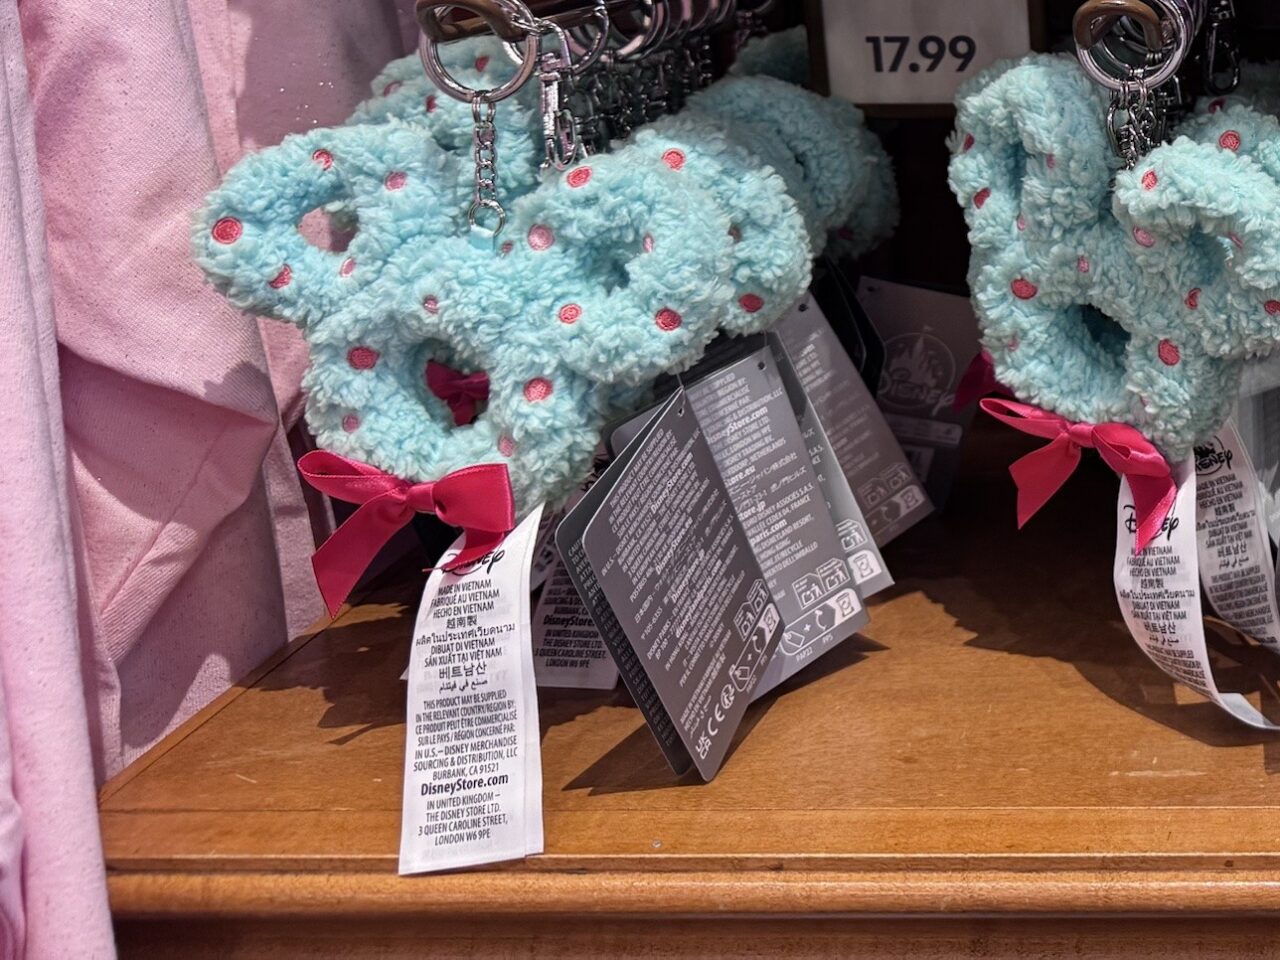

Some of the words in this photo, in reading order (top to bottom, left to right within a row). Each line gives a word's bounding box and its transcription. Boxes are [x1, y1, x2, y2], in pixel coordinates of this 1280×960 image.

[865, 35, 977, 73] 17.99
[650, 452, 694, 517] DisneyStore.com
[791, 494, 811, 510] FRANCE
[438, 584, 453, 595] MADE
[453, 583, 460, 593] IN
[461, 579, 491, 591] VIETNAM
[431, 642, 453, 655] DIBUAT
[455, 641, 462, 651] DI
[465, 636, 495, 650] VIETNAM
[439, 661, 486, 680] 베트남산
[415, 749, 422, 759] IN
[444, 742, 469, 755] DISNEY
[470, 735, 516, 751] MERCHANDISE
[413, 756, 448, 771] SOURCING
[449, 756, 455, 766] &
[456, 748, 504, 765] DISTRIBUTION,
[506, 746, 517, 757] LLC
[432, 766, 467, 781] BURBANK,
[468, 764, 478, 775] CA
[479, 761, 498, 773] 91521
[420, 771, 508, 798] DisneyStore.com
[426, 799, 435, 810] IN
[436, 796, 460, 809] UNITED
[462, 791, 494, 805] KINGDOM
[426, 810, 439, 822] THE
[440, 807, 465, 820] DISNEY
[466, 804, 485, 817] STORE
[487, 802, 500, 814] LTD.
[418, 825, 422, 836] 3
[424, 822, 447, 835] QUEEN
[448, 817, 481, 832] CAROLINE
[482, 813, 507, 827] STREET,
[434, 831, 464, 846] LONDON
[466, 830, 477, 841] W6
[478, 828, 490, 840] 9PE
